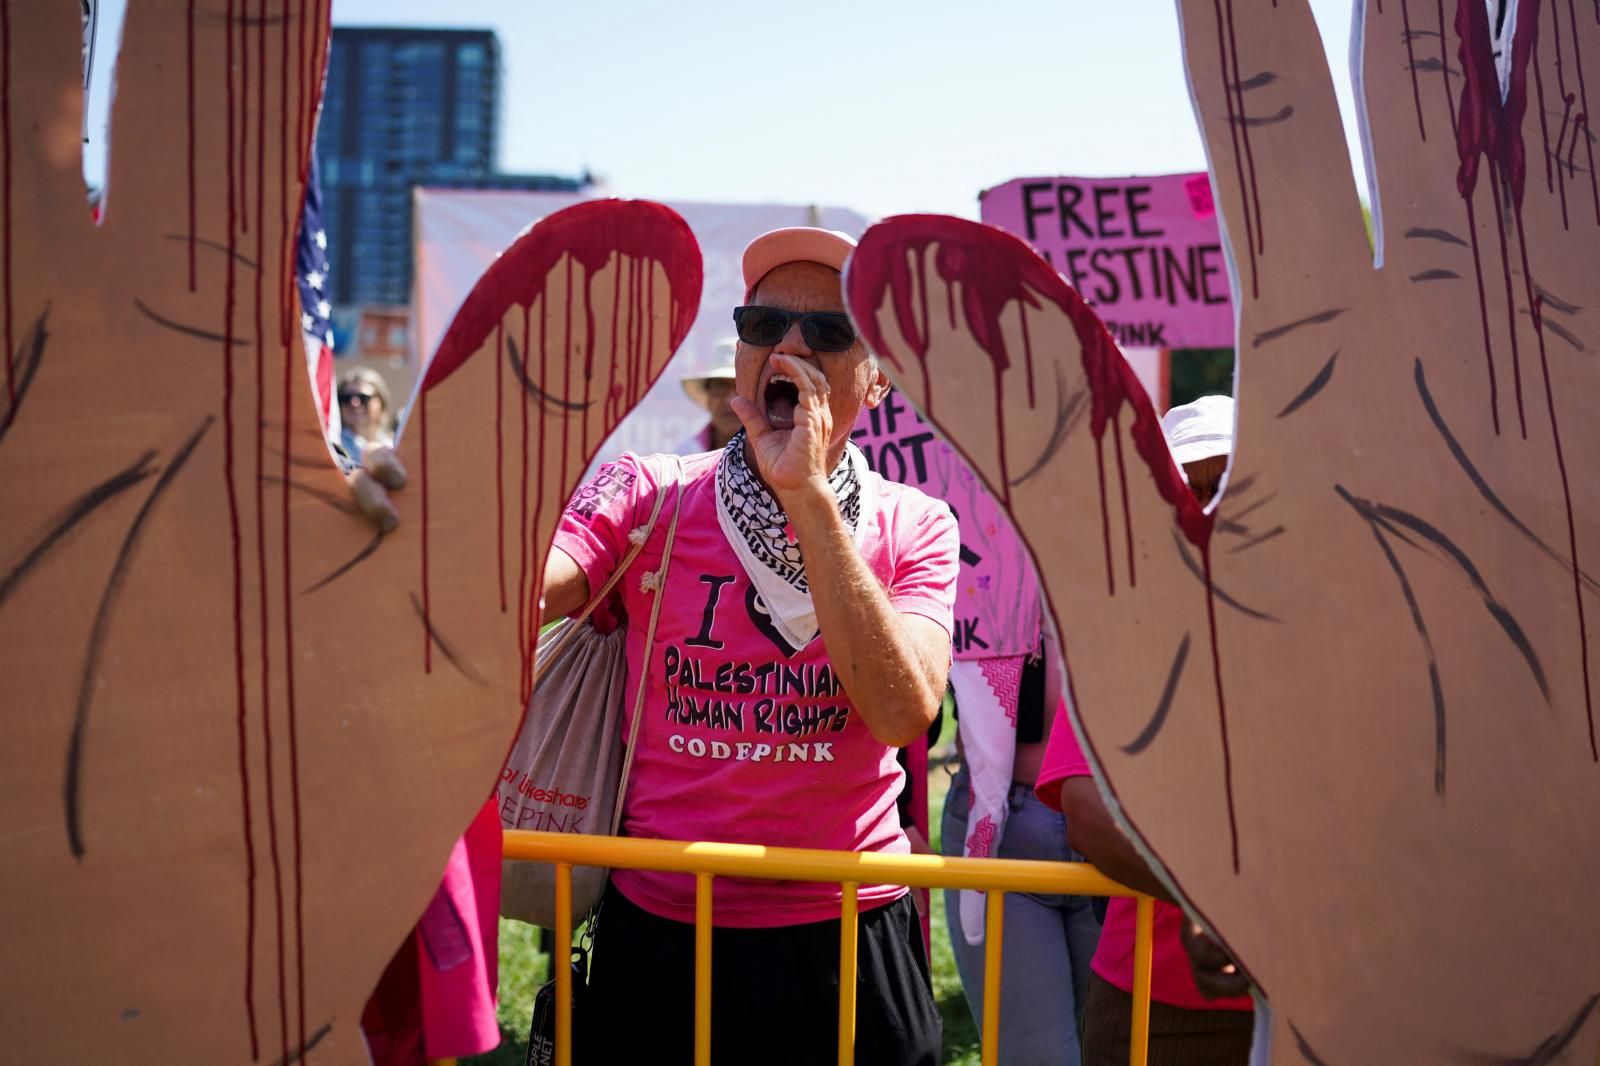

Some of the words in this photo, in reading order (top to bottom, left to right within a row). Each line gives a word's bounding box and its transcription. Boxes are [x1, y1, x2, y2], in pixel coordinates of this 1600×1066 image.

[1021, 183, 1165, 240] FREE
[1045, 244, 1229, 305] ESTINE
[684, 574, 736, 649] I
[665, 686, 746, 732] HUMAN
[752, 698, 849, 738] RIGHTS
[668, 734, 835, 762] CODEPINK
